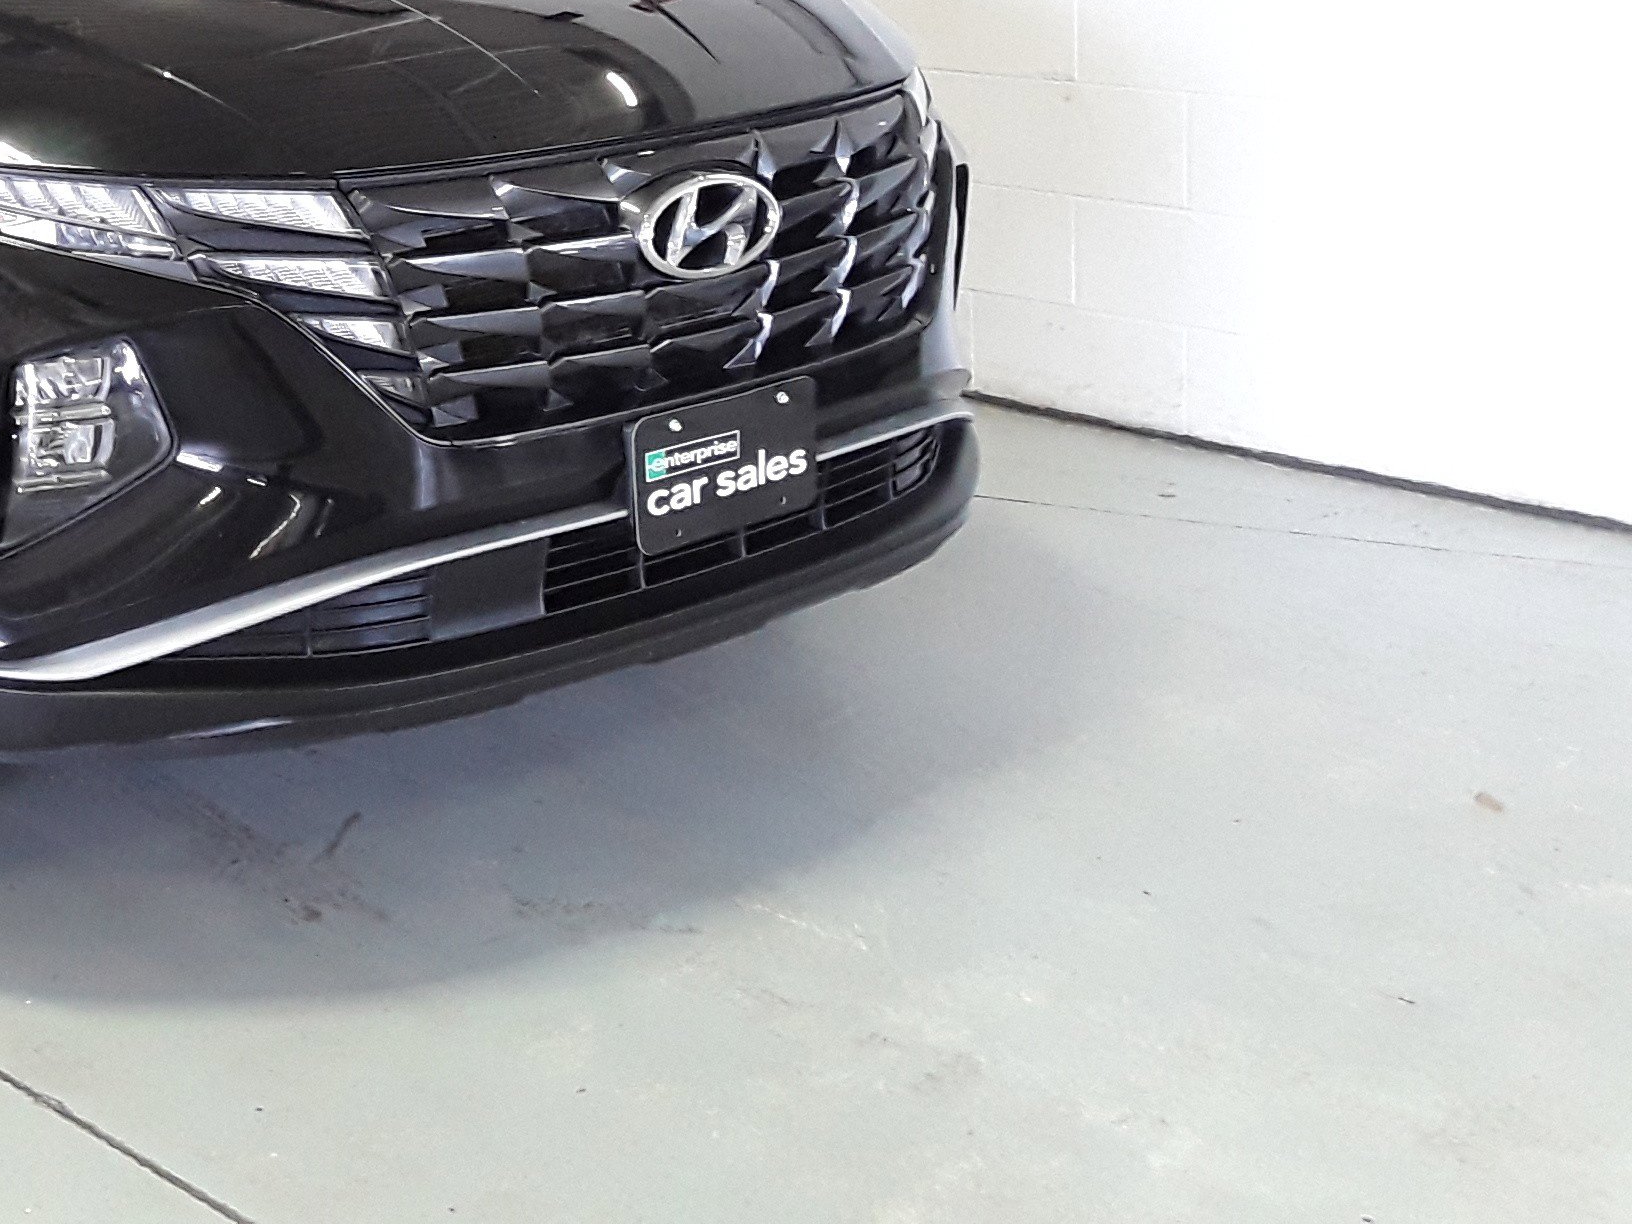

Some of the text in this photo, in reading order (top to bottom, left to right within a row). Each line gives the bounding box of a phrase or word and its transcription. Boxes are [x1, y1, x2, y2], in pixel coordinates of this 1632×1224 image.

[647, 439, 738, 472] enterprise
[646, 447, 808, 517] car sales
